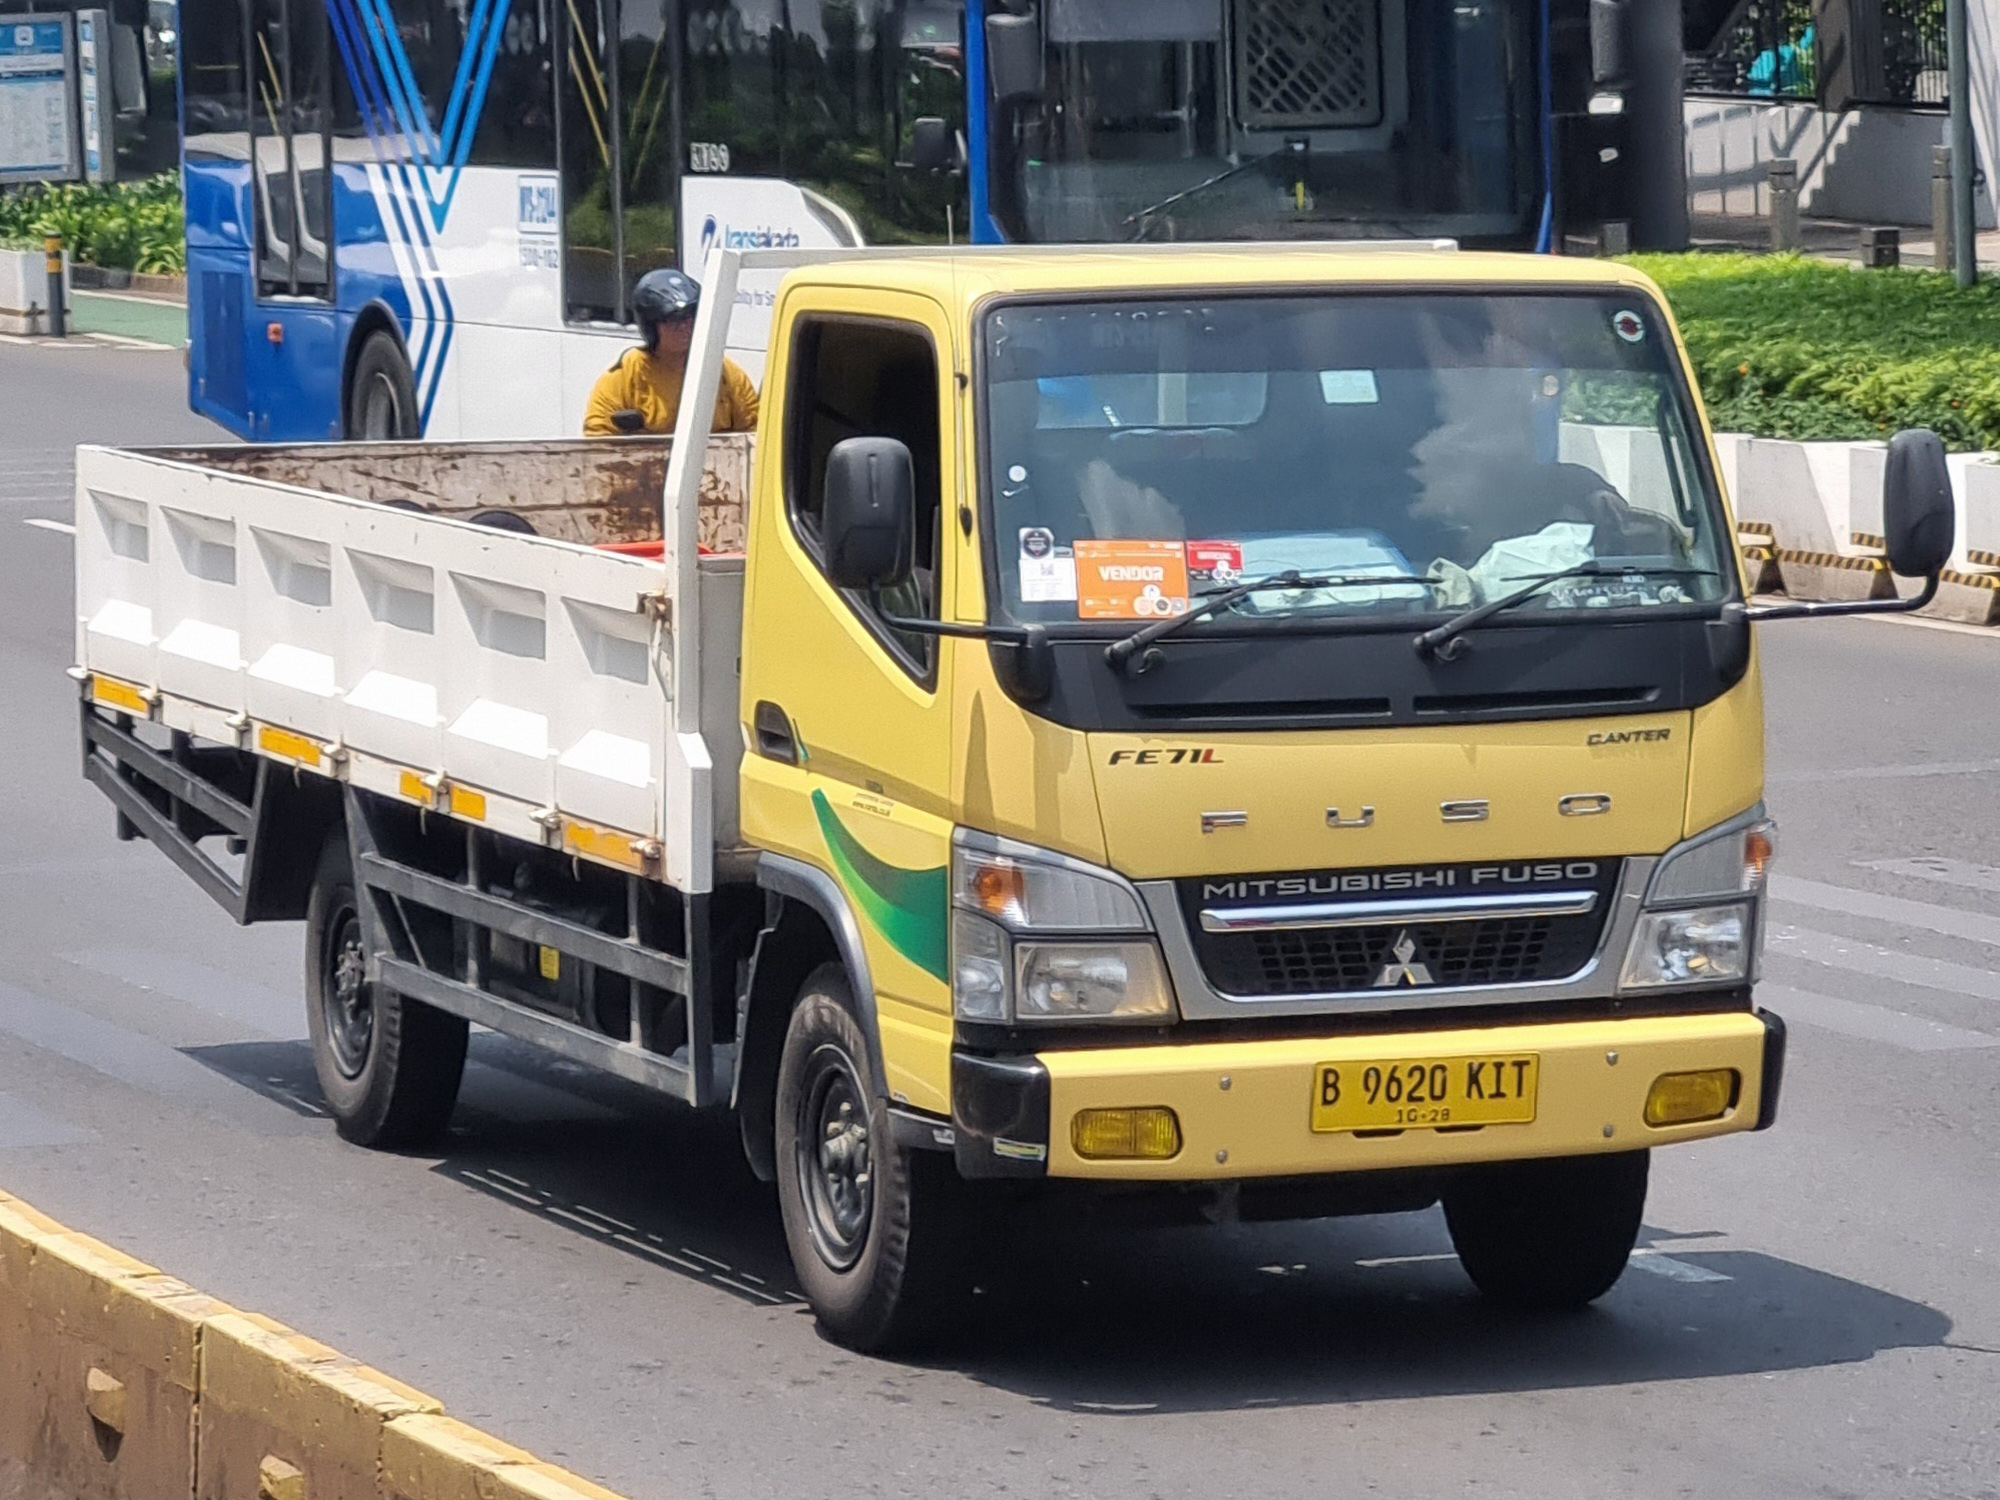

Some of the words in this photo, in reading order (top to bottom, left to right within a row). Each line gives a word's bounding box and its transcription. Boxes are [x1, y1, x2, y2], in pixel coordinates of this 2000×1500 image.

[1098, 565, 1165, 582] VENDOR
[1587, 728, 1671, 747] CANTER
[1108, 748, 1225, 766] FE71L
[1201, 792, 1612, 835] FUSO
[1203, 869, 1456, 900] MITSUBISHI
[1471, 861, 1599, 885] FUSO
[1321, 1067, 1341, 1106] B
[1363, 1064, 1448, 1105] 9620
[1466, 1060, 1531, 1099] KIT
